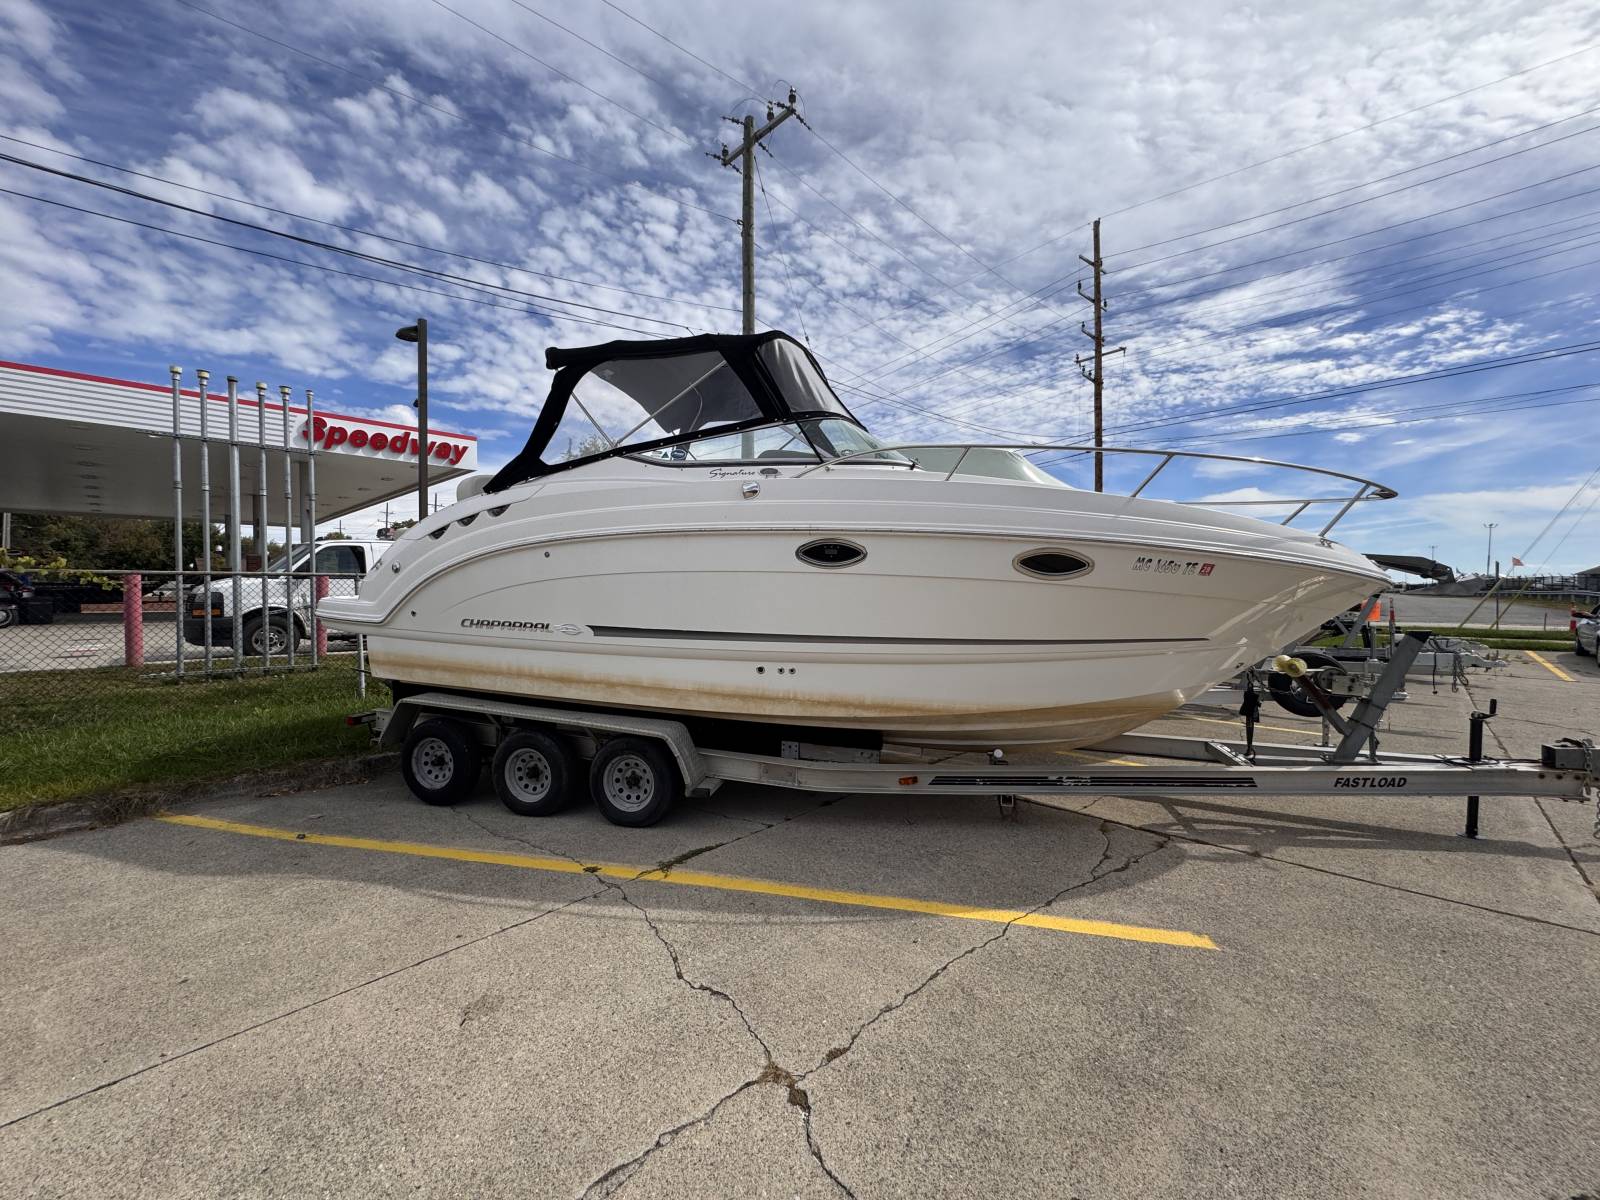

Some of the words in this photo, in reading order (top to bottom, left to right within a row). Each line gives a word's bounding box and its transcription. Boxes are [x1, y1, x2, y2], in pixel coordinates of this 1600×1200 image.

[302, 416, 469, 465] Speedway
[709, 467, 756, 479] Signature
[1132, 556, 1152, 571] MC
[460, 618, 554, 633] CHAPARRAL
[1334, 777, 1407, 788] FASTLOAD
